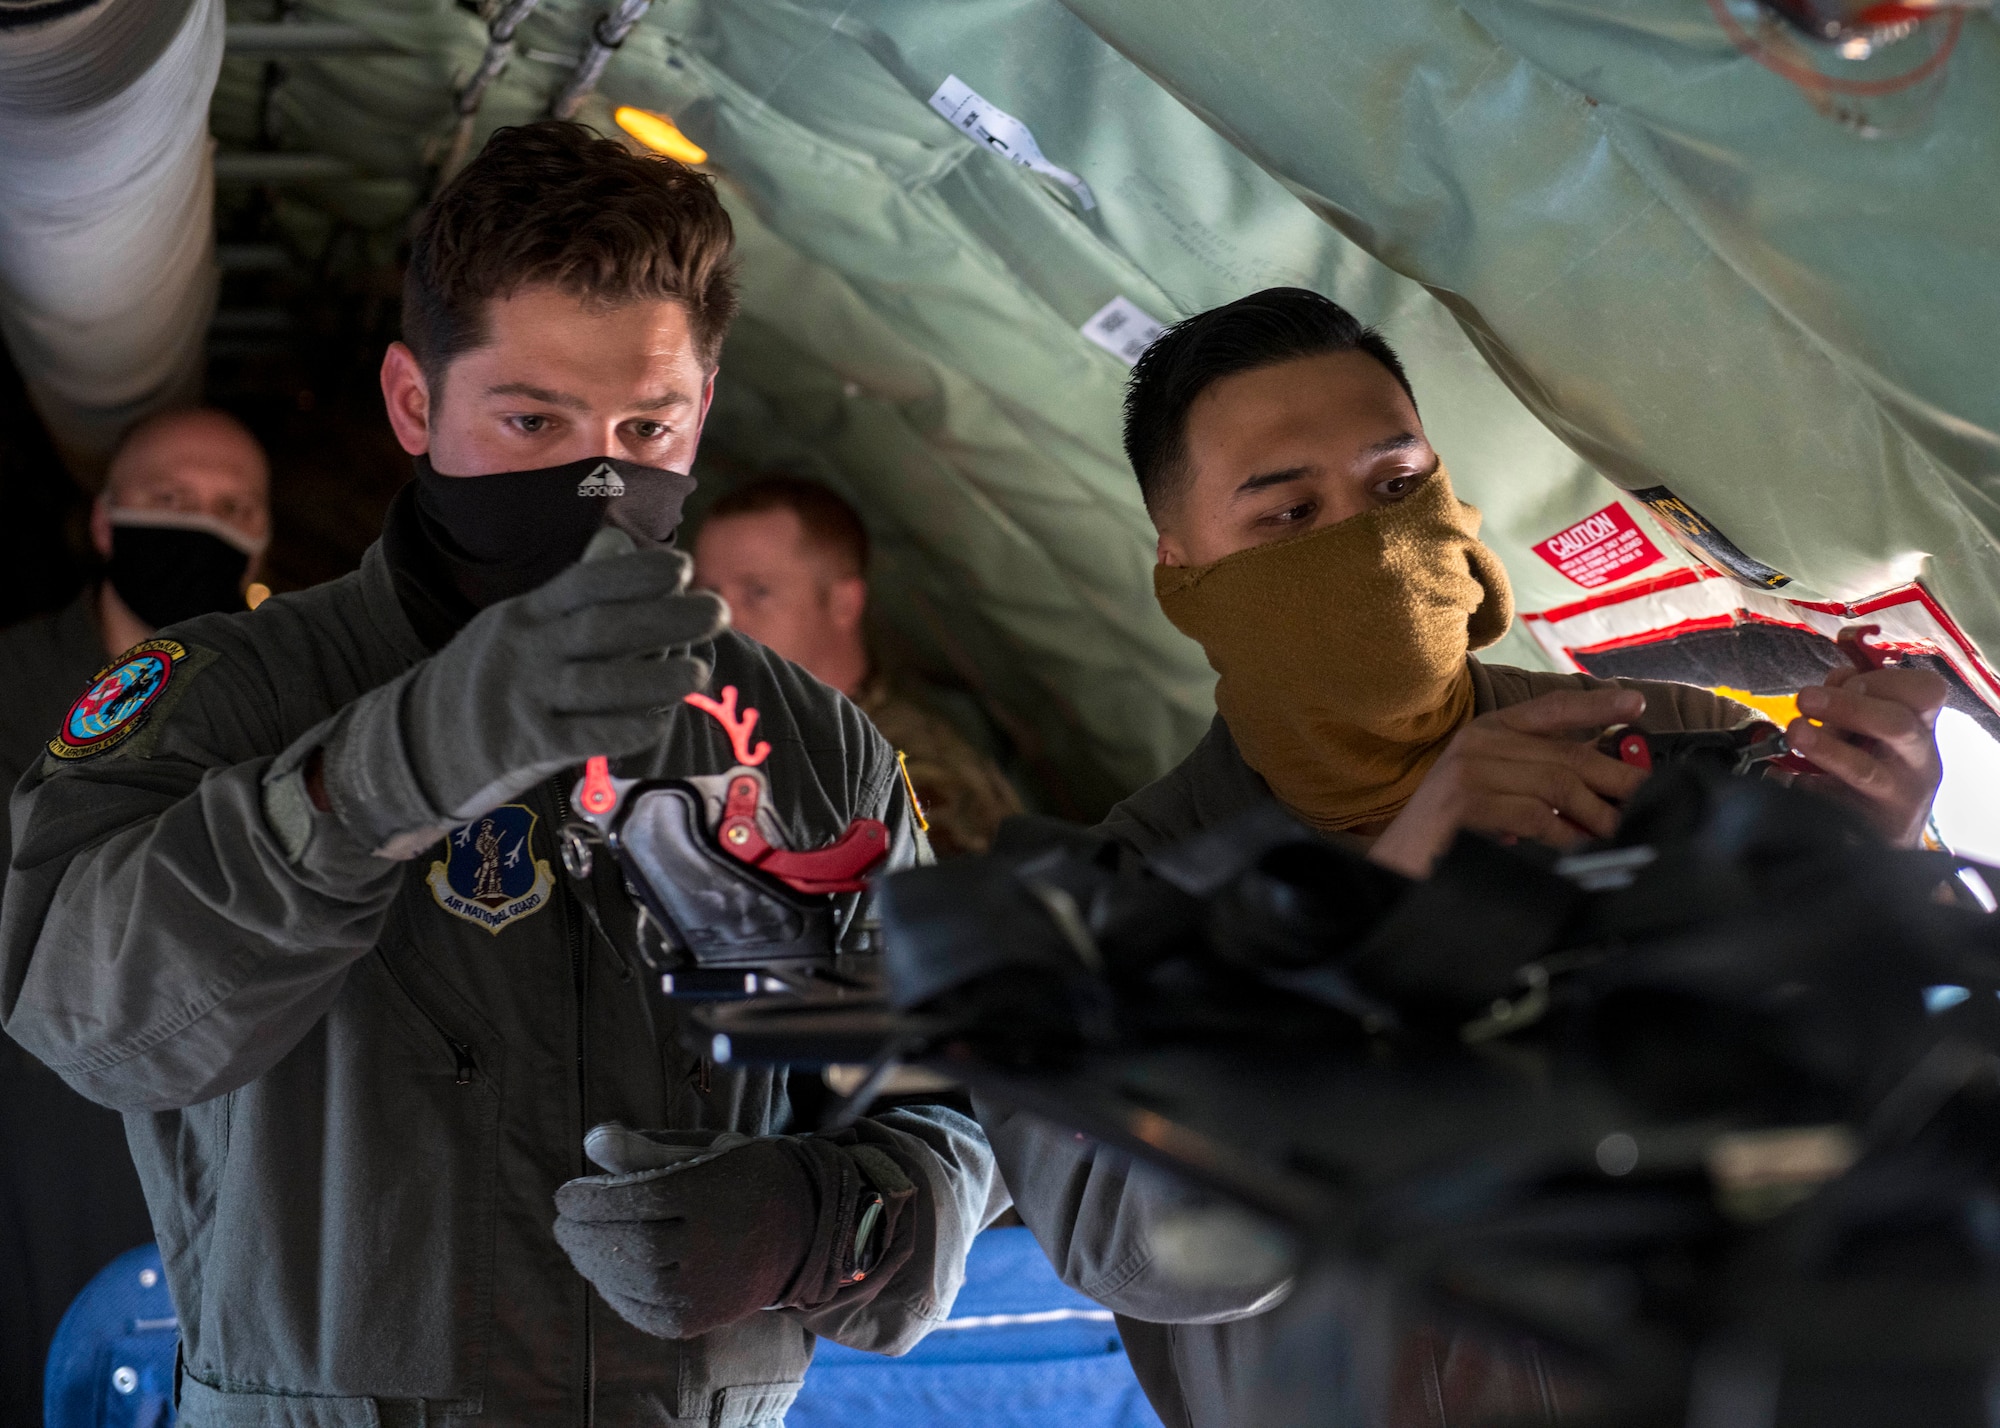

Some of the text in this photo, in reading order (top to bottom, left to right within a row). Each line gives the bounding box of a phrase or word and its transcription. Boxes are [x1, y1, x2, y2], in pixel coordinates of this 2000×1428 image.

[1547, 512, 1617, 557] CAUTION
[444, 894, 541, 926] AIR NATIONAL GUARD
